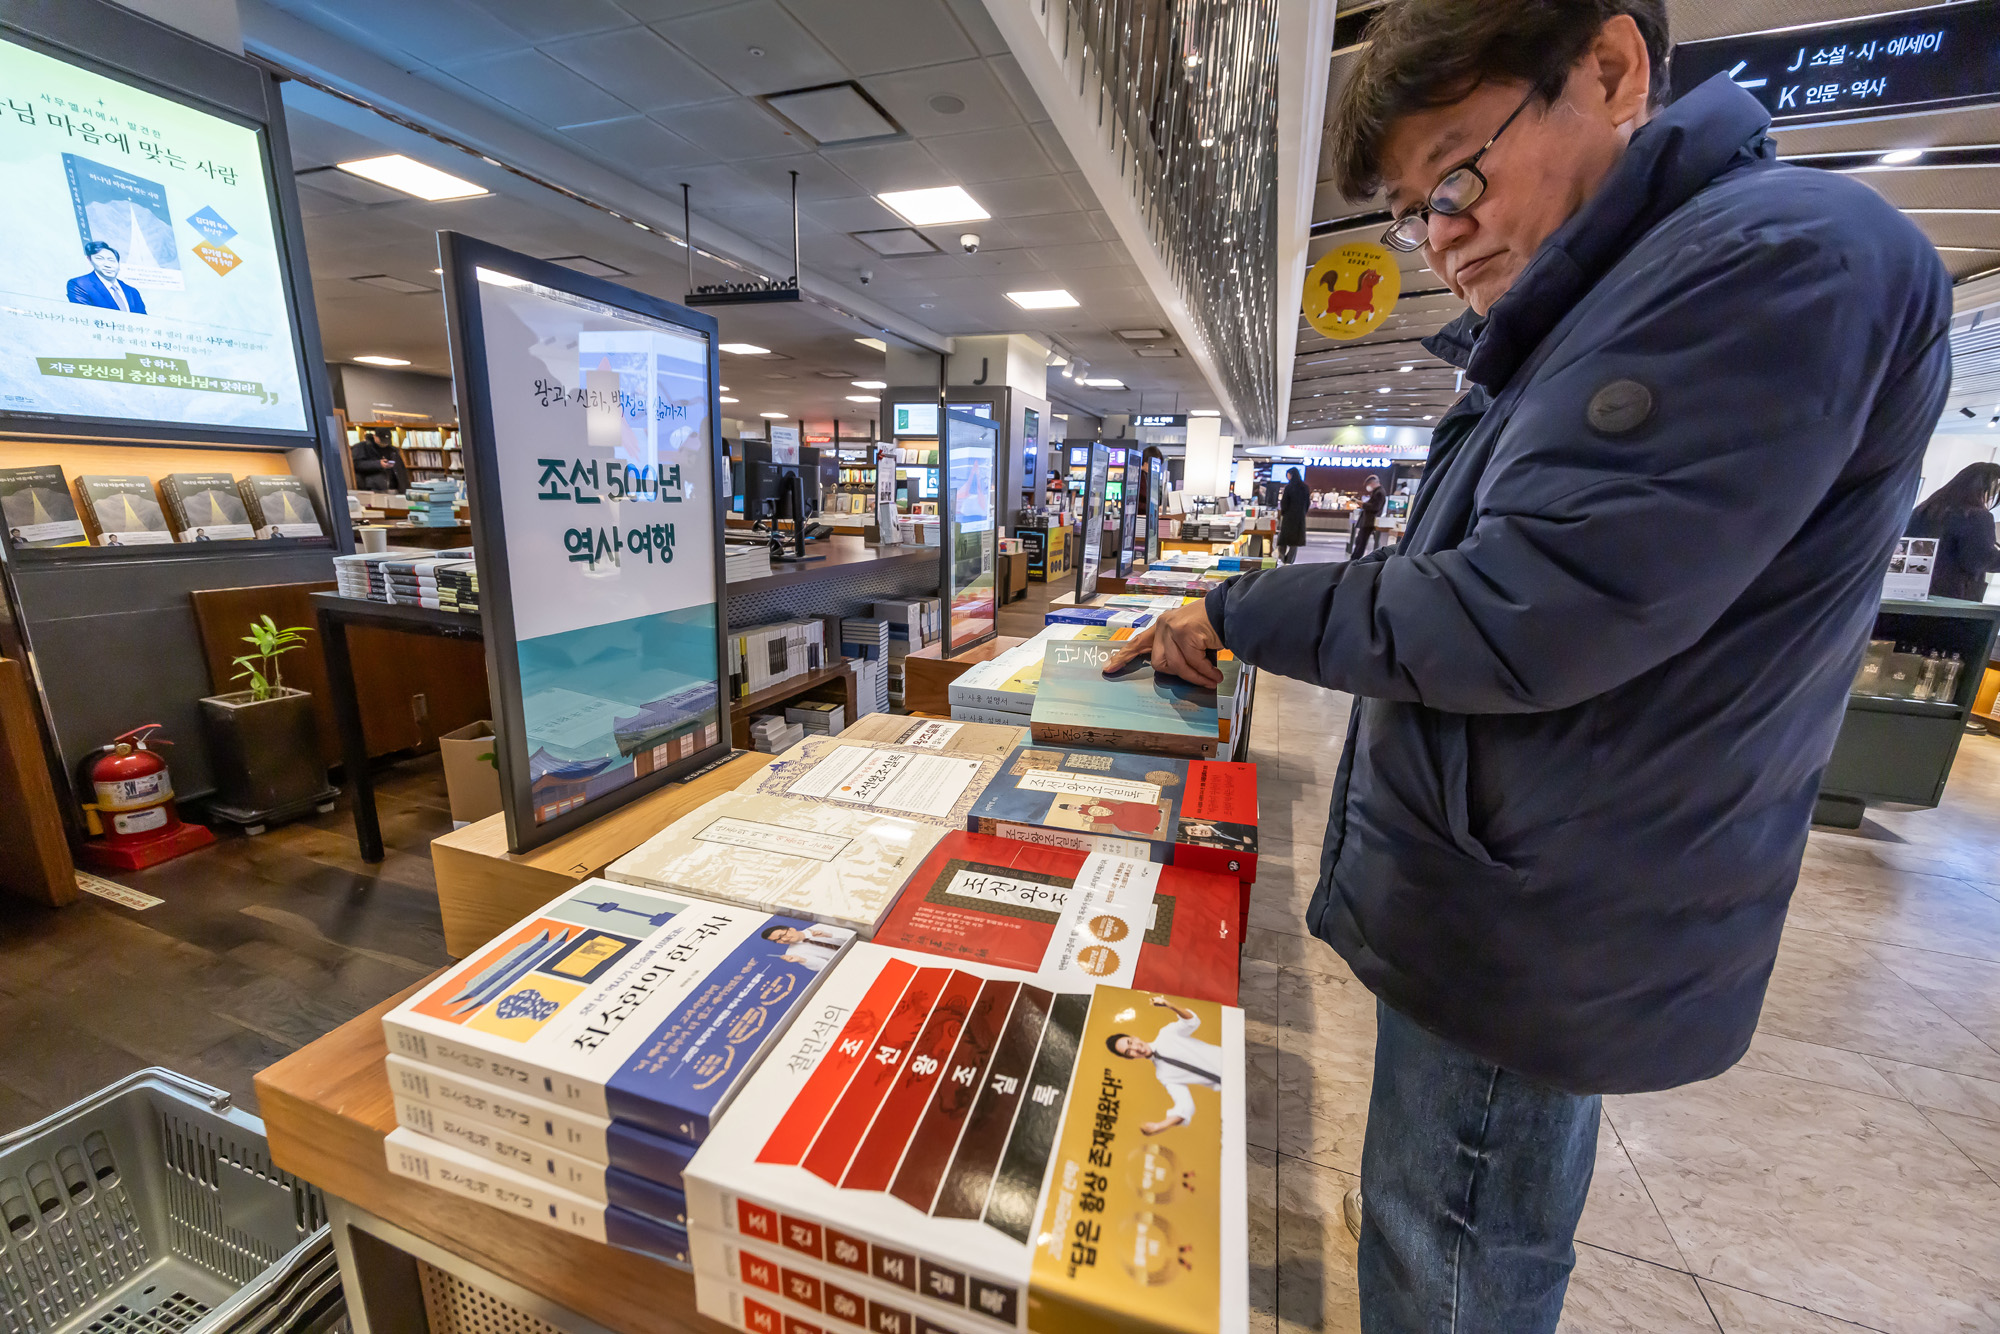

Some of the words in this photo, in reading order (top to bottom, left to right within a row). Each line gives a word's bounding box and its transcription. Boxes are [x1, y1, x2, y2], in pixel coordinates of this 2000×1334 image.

[1787, 48, 1805, 72] J
[1778, 85, 1800, 109] K
[1806, 77, 1886, 105] 인문·역사
[40, 93, 119, 125] 사무엘서에서
[128, 121, 161, 139] 발견한
[0, 98, 36, 126] 님
[47, 113, 130, 154] 마음에
[139, 140, 186, 170] 맞는
[196, 160, 238, 186] 사람
[50, 362, 76, 374] 지금
[78, 364, 124, 381] 당신의
[128, 369, 167, 384] 중심을
[169, 374, 217, 389] 하나님께
[220, 380, 256, 394] 맞춰라!
[139, 357, 151, 368] 단
[973, 357, 988, 385] J
[1303, 457, 1392, 468] STARBUCKS
[538, 458, 602, 504] 조선
[607, 463, 682, 503] 500년
[564, 526, 623, 571] 역사
[627, 523, 675, 564] 여행
[958, 693, 964, 701] 나
[968, 694, 982, 703] 사용
[986, 696, 1008, 706] 설명서
[1041, 727, 1123, 745] 단종애사
[124, 781, 137, 795] SW
[854, 755, 905, 799] 조선왕조실록
[1029, 779, 1144, 799] 조선왕조실록
[1006, 829, 1084, 850] 조선왕조실록
[571, 963, 675, 1054] 최소한의
[668, 914, 733, 964] 한국사
[578, 1002, 597, 1016] 5천
[593, 992, 608, 1002] 년
[604, 968, 634, 992] 역사가
[786, 1005, 849, 1075] 설민석의
[1080, 1171, 1108, 1214] 항상
